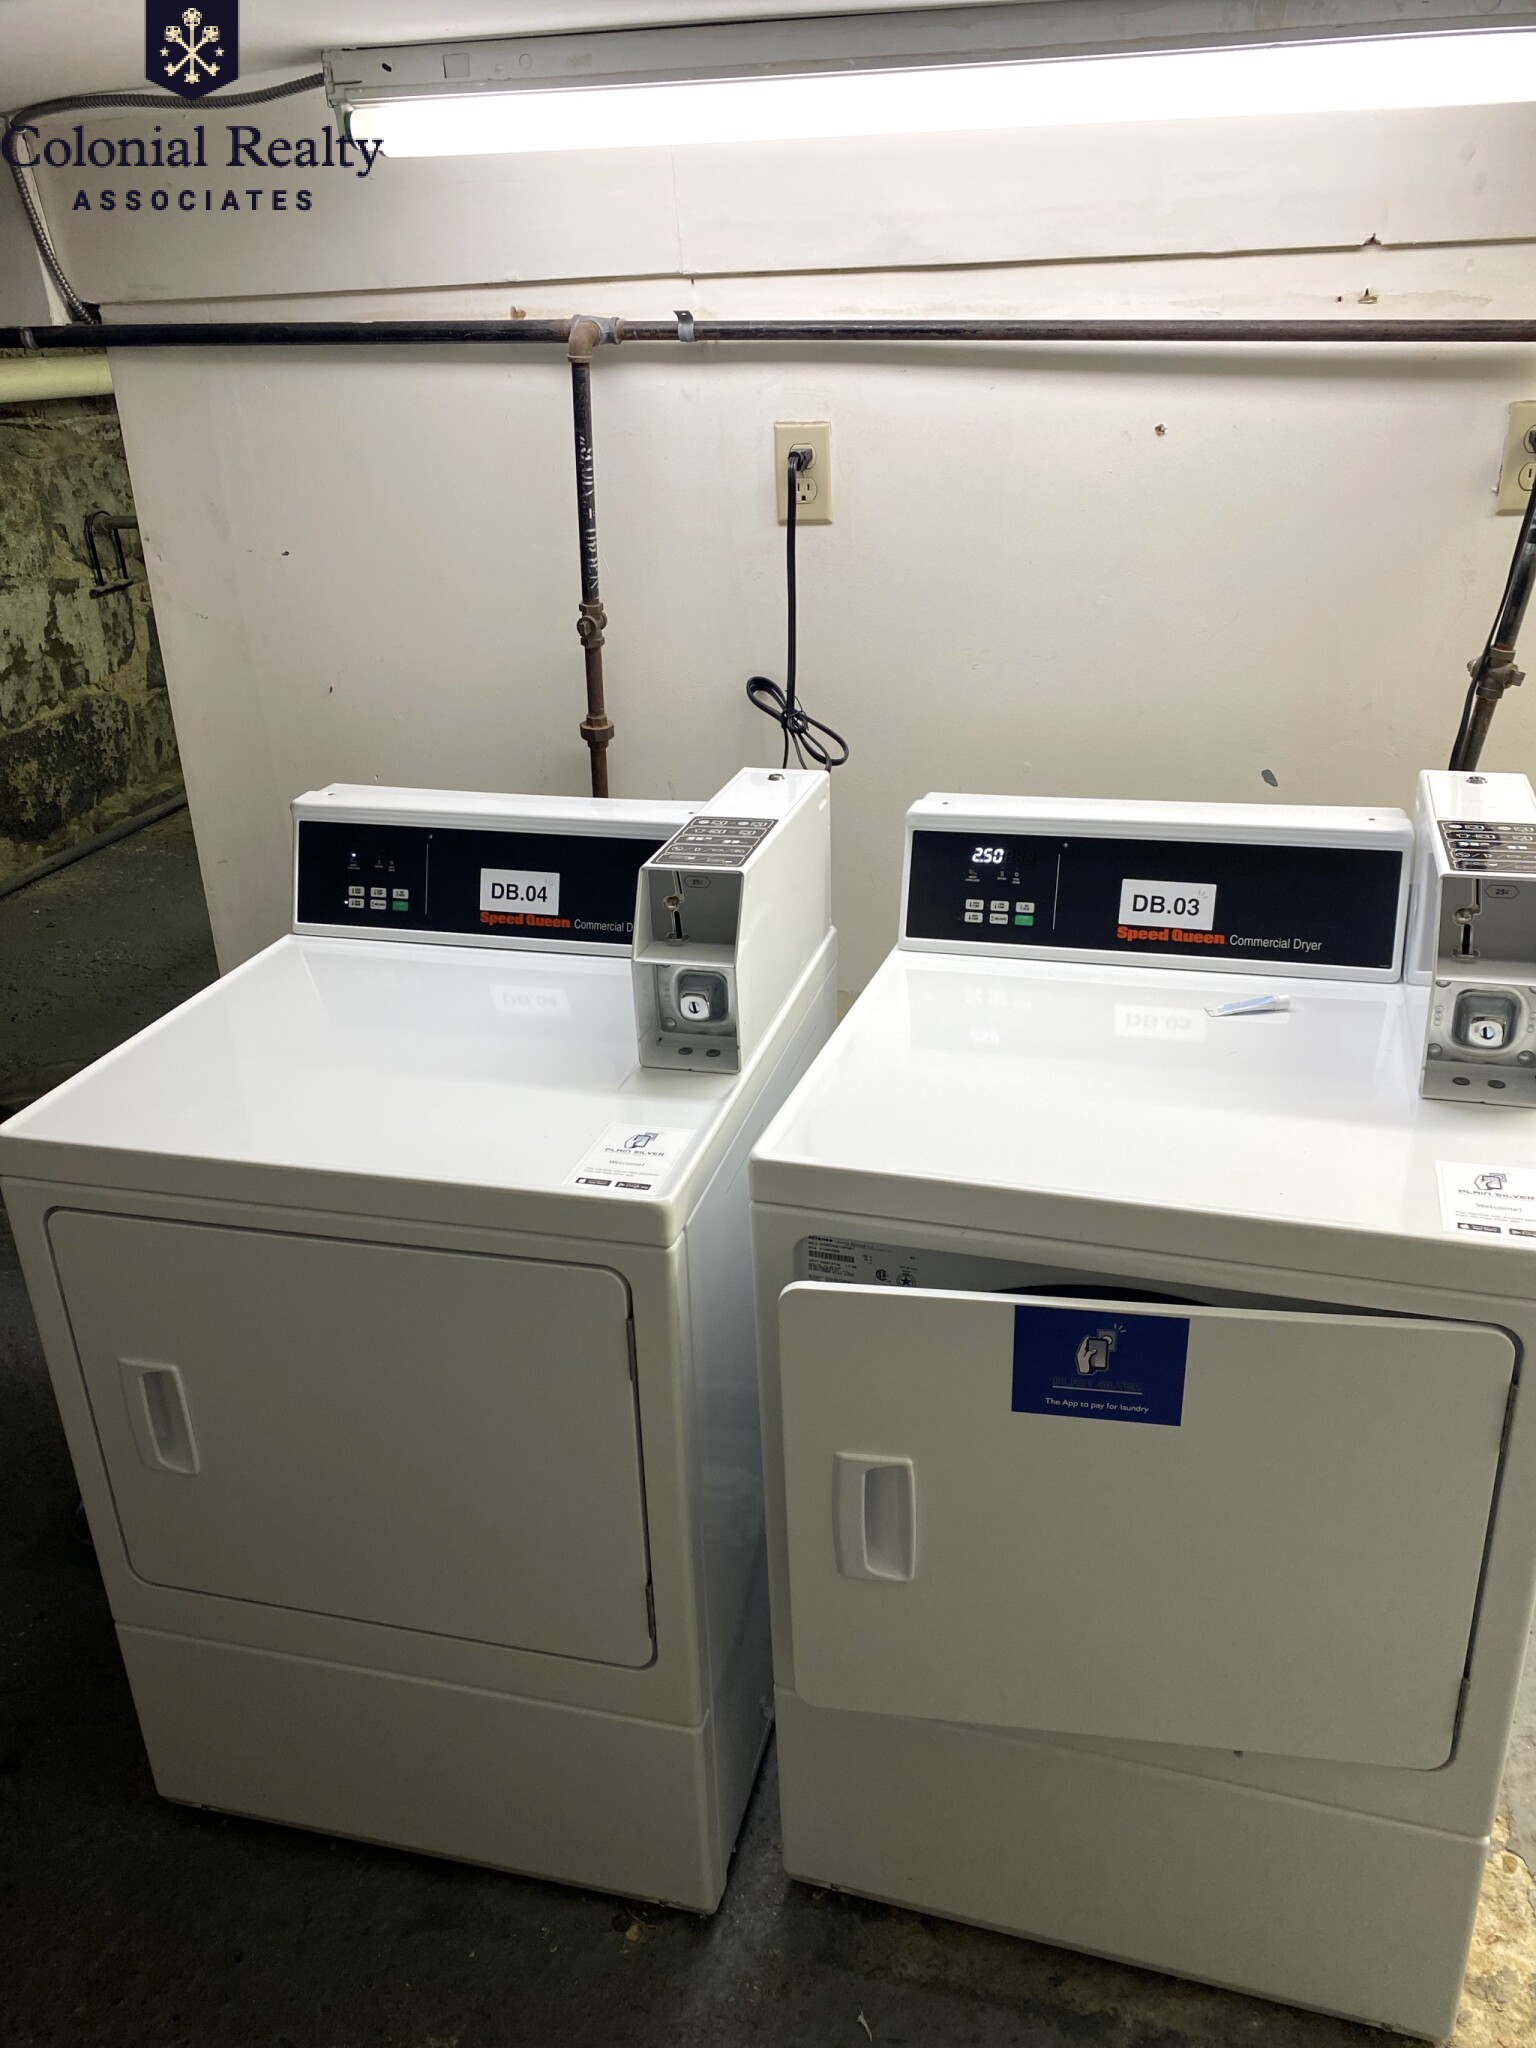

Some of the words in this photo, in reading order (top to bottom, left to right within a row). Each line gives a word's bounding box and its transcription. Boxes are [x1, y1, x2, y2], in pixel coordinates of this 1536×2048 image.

[491, 882, 548, 903] DB.04
[1132, 893, 1200, 916] DB.03
[480, 911, 524, 926] Speed
[525, 913, 571, 928] Queen
[574, 918, 625, 932] Commercial
[1116, 926, 1169, 942] Speed
[1171, 928, 1225, 945] Queen
[1229, 934, 1290, 949] Commercial
[1293, 938, 1323, 953] Dryer
[1045, 1397, 1061, 1406] The
[1062, 1399, 1079, 1408] App
[1090, 1402, 1105, 1411] pay
[1106, 1402, 1118, 1410] for
[1119, 1404, 1150, 1414] laundry
